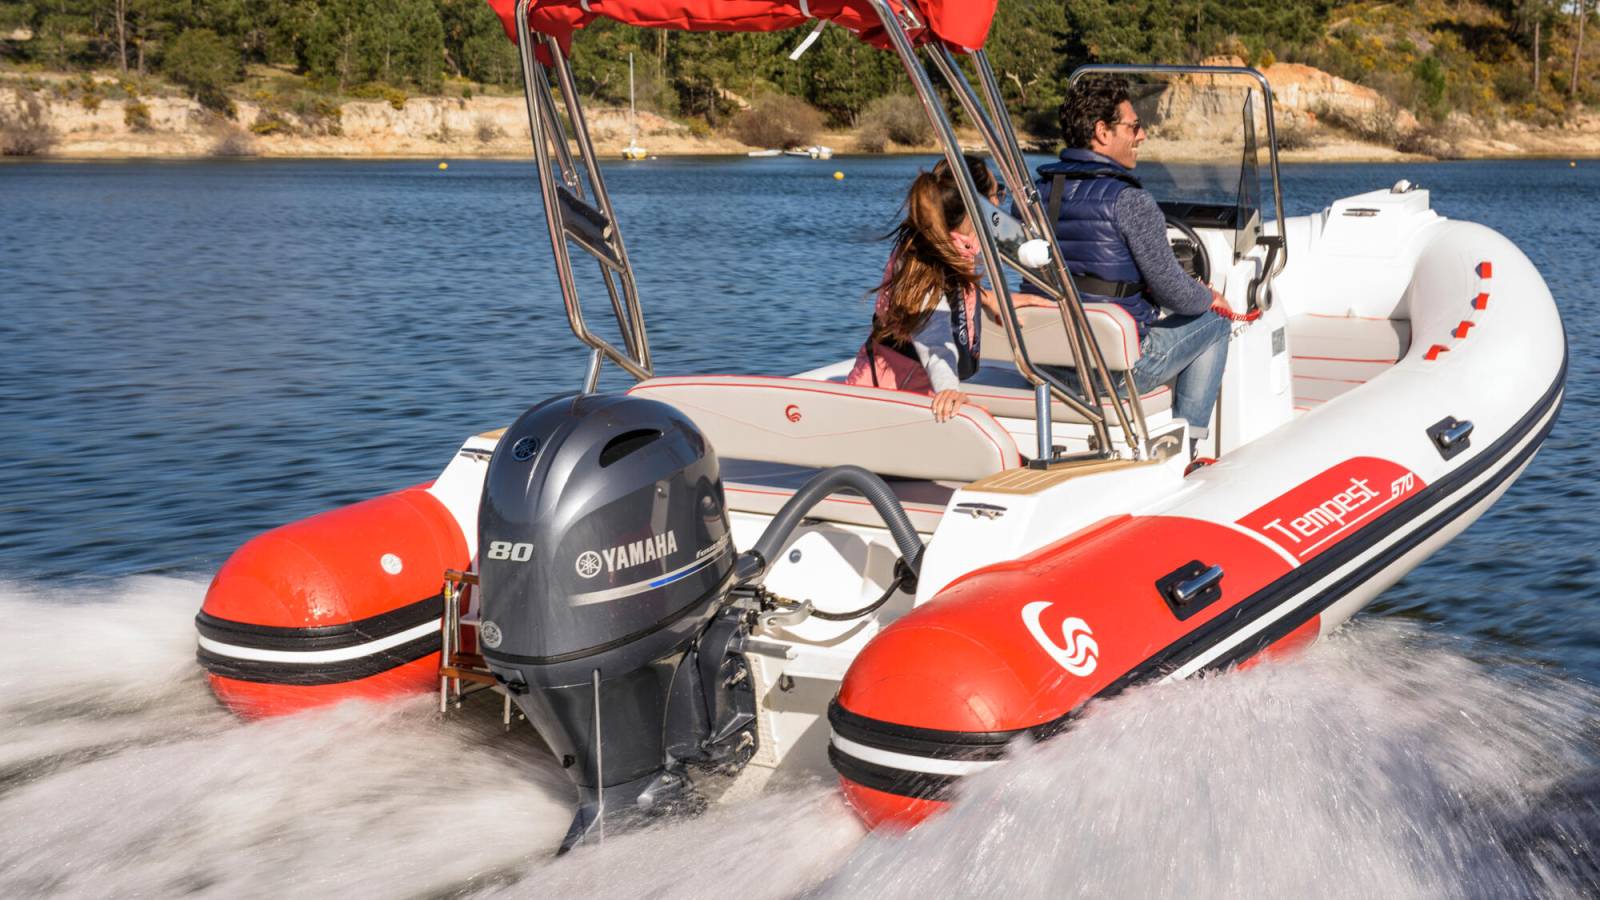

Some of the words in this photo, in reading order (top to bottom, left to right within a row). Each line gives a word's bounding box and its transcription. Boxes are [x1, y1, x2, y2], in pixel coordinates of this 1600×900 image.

[1263, 477, 1380, 543] Tempest
[1391, 471, 1415, 500] 570
[487, 541, 534, 562] 80
[602, 530, 678, 573] YAMAHA
